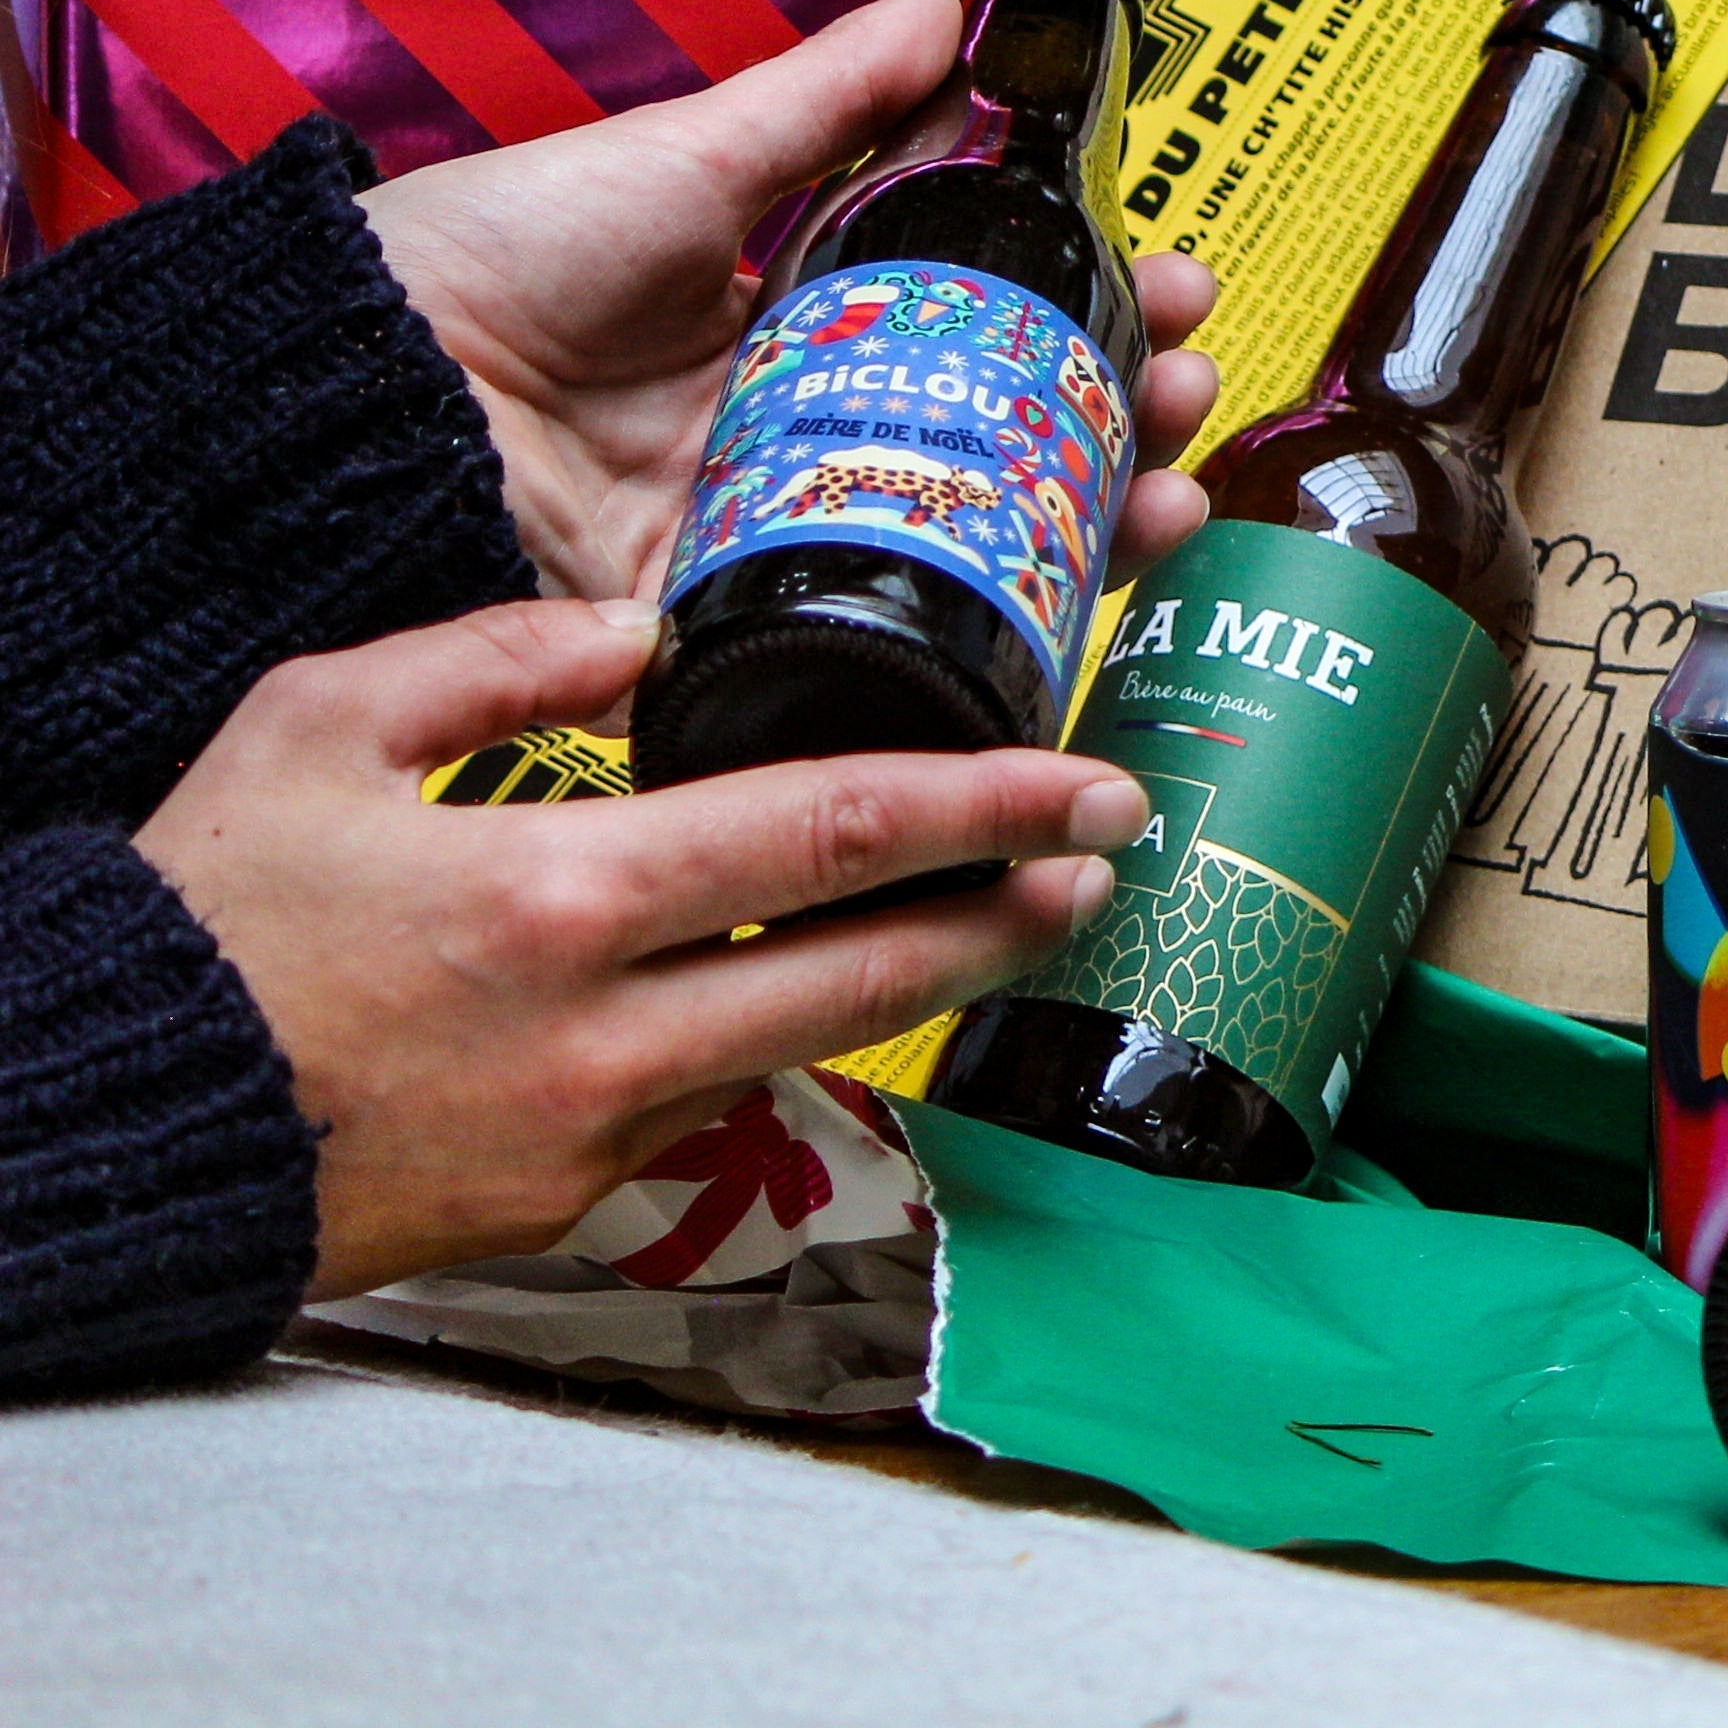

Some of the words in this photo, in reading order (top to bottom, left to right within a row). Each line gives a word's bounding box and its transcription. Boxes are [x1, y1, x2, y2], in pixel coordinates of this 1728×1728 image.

[1123, 128, 1201, 222] DU
[1196, 159, 1249, 221] UNE
[1241, 41, 1329, 156] CH'TITE
[1199, 328, 1217, 348] de
[1211, 278, 1252, 327] laisser
[1246, 203, 1304, 277] fermenter
[1300, 172, 1326, 202] une
[1321, 113, 1366, 172] mixture
[1361, 91, 1380, 113] de
[1376, 30, 1423, 91] céréales
[1412, 9, 1436, 29] et
[1221, 232, 1235, 247] il
[1231, 181, 1271, 234] n'aura
[1267, 111, 1318, 181] échappé
[1313, 98, 1327, 111] à
[1323, 21, 1378, 102] personne
[1224, 256, 1243, 278] en
[1238, 202, 1279, 256] faveur
[1277, 179, 1295, 202] de
[1290, 162, 1308, 180] la
[1335, 92, 1356, 114] La
[1350, 46, 1386, 92] faute
[1382, 34, 1395, 46] à
[1389, 16, 1407, 34] la
[1233, 296, 1265, 333] mais
[1260, 244, 1299, 297] autour
[1296, 222, 1316, 244] du
[1356, 113, 1391, 158] avant
[1406, 56, 1430, 78] les
[1423, 12, 1460, 55] Grecs
[1217, 367, 1262, 424] cultiver
[1255, 351, 1274, 368] le
[1301, 275, 1329, 308] peu
[1324, 221, 1365, 275] adapté
[1408, 130, 1427, 153] de
[1261, 308, 1280, 329] de
[1354, 156, 1385, 195] pour
[1288, 310, 1326, 359] offert
[1320, 285, 1346, 315] aux
[784, 413, 868, 438] BIÈRE
[871, 421, 911, 442] DE
[1101, 598, 1183, 669] LA
[1195, 598, 1375, 706] MIE
[1118, 670, 1178, 701] Bière
[1178, 687, 1215, 706] au
[1210, 690, 1277, 722] pain
